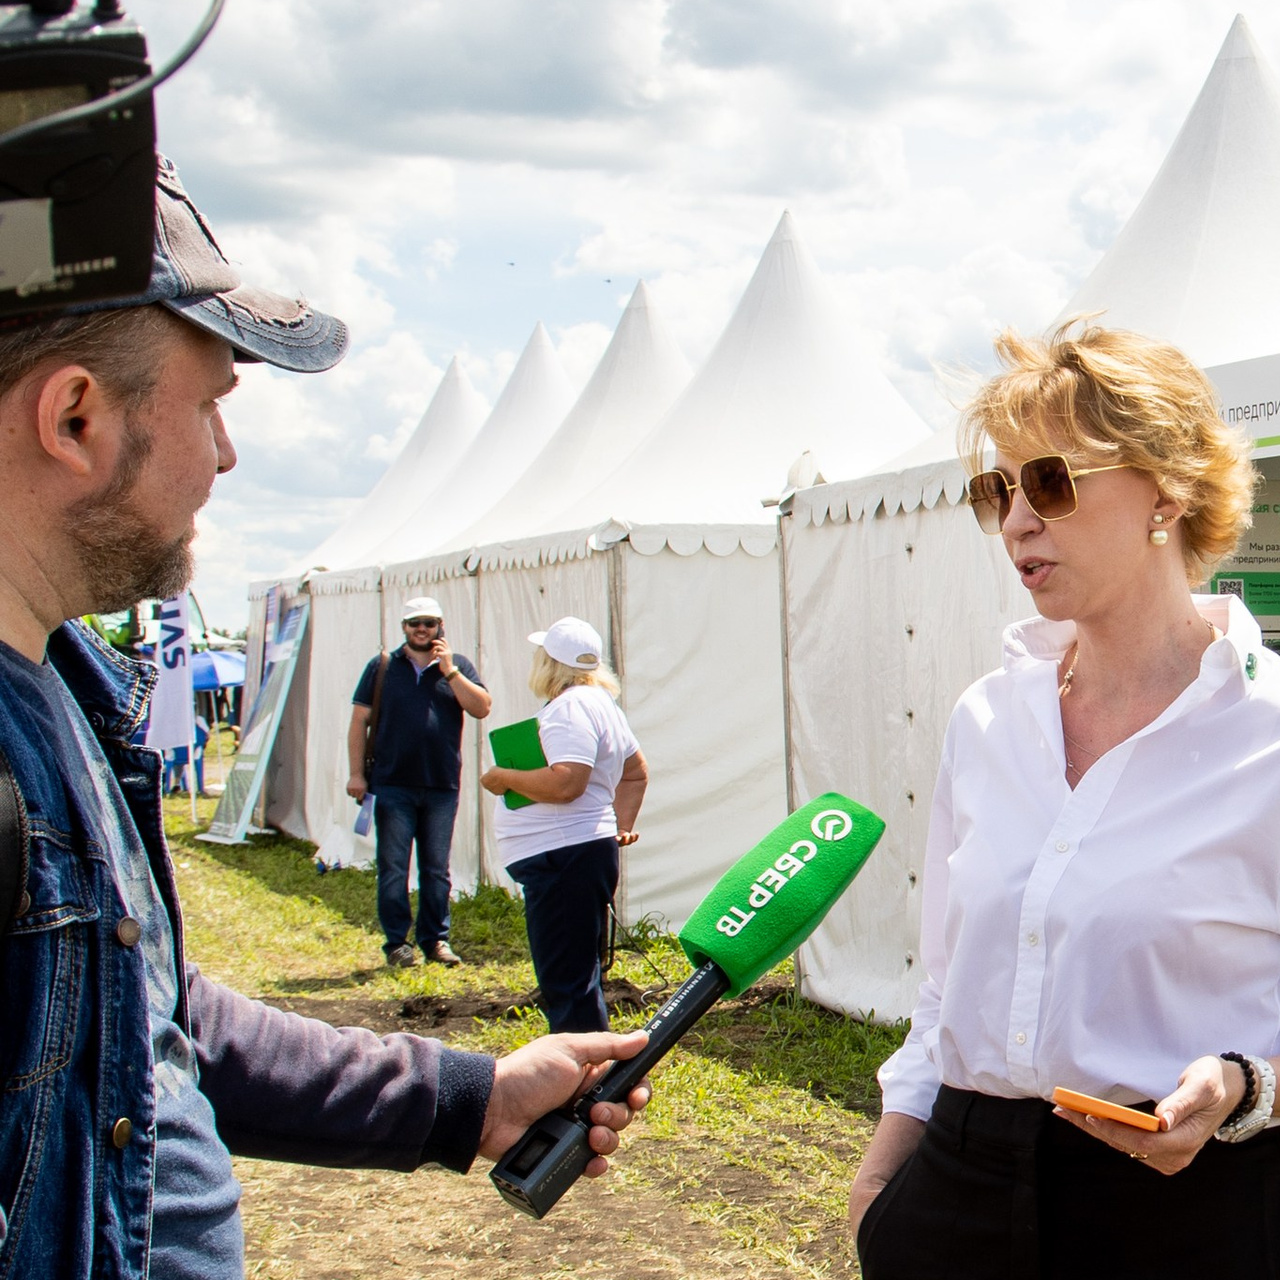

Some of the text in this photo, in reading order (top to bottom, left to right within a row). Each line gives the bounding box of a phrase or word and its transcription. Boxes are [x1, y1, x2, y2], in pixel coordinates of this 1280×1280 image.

[1249, 542, 1264, 551] Мы
[716, 840, 817, 938] СБЕР ТВ
[662, 971, 706, 1018] SENNHEISER
